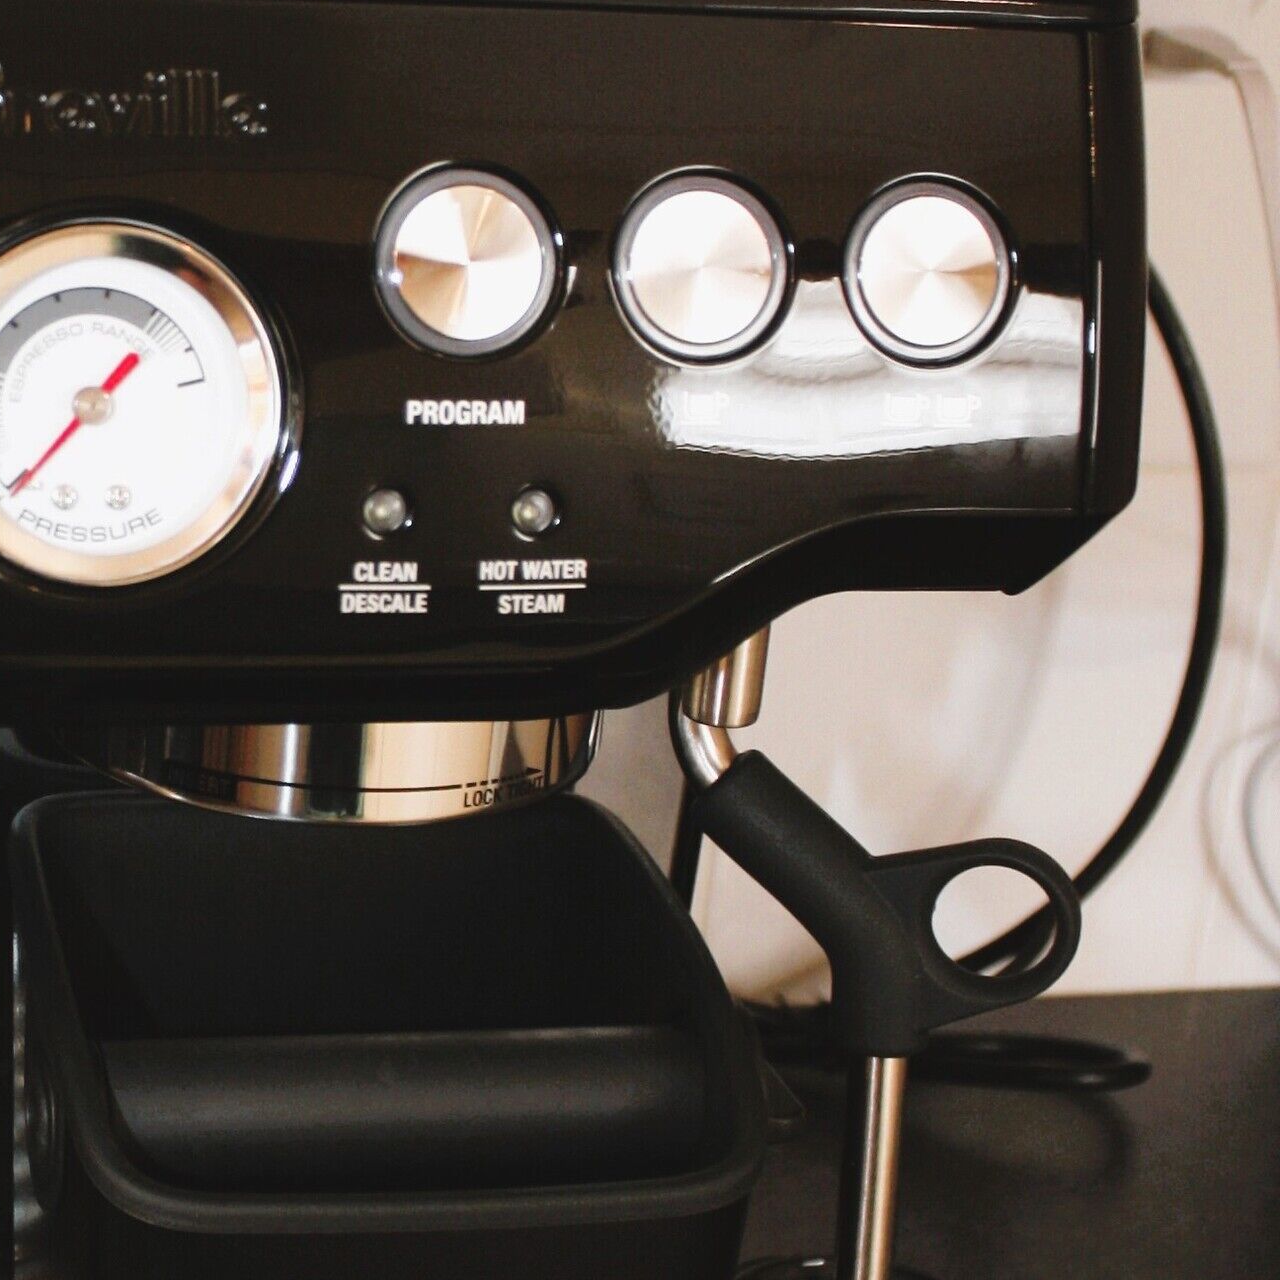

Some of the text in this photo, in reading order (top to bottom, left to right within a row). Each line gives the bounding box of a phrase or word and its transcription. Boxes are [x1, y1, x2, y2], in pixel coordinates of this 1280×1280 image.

[11, 323, 84, 403] ESPRESSO
[405, 399, 526, 426] PROGRAM
[18, 508, 164, 542] PRESSURE
[353, 561, 418, 583] CLEAN
[479, 558, 588, 582] HOT WATER
[340, 592, 428, 614] DESCALE
[497, 593, 565, 615] STEAM
[463, 786, 503, 808] LOCK
